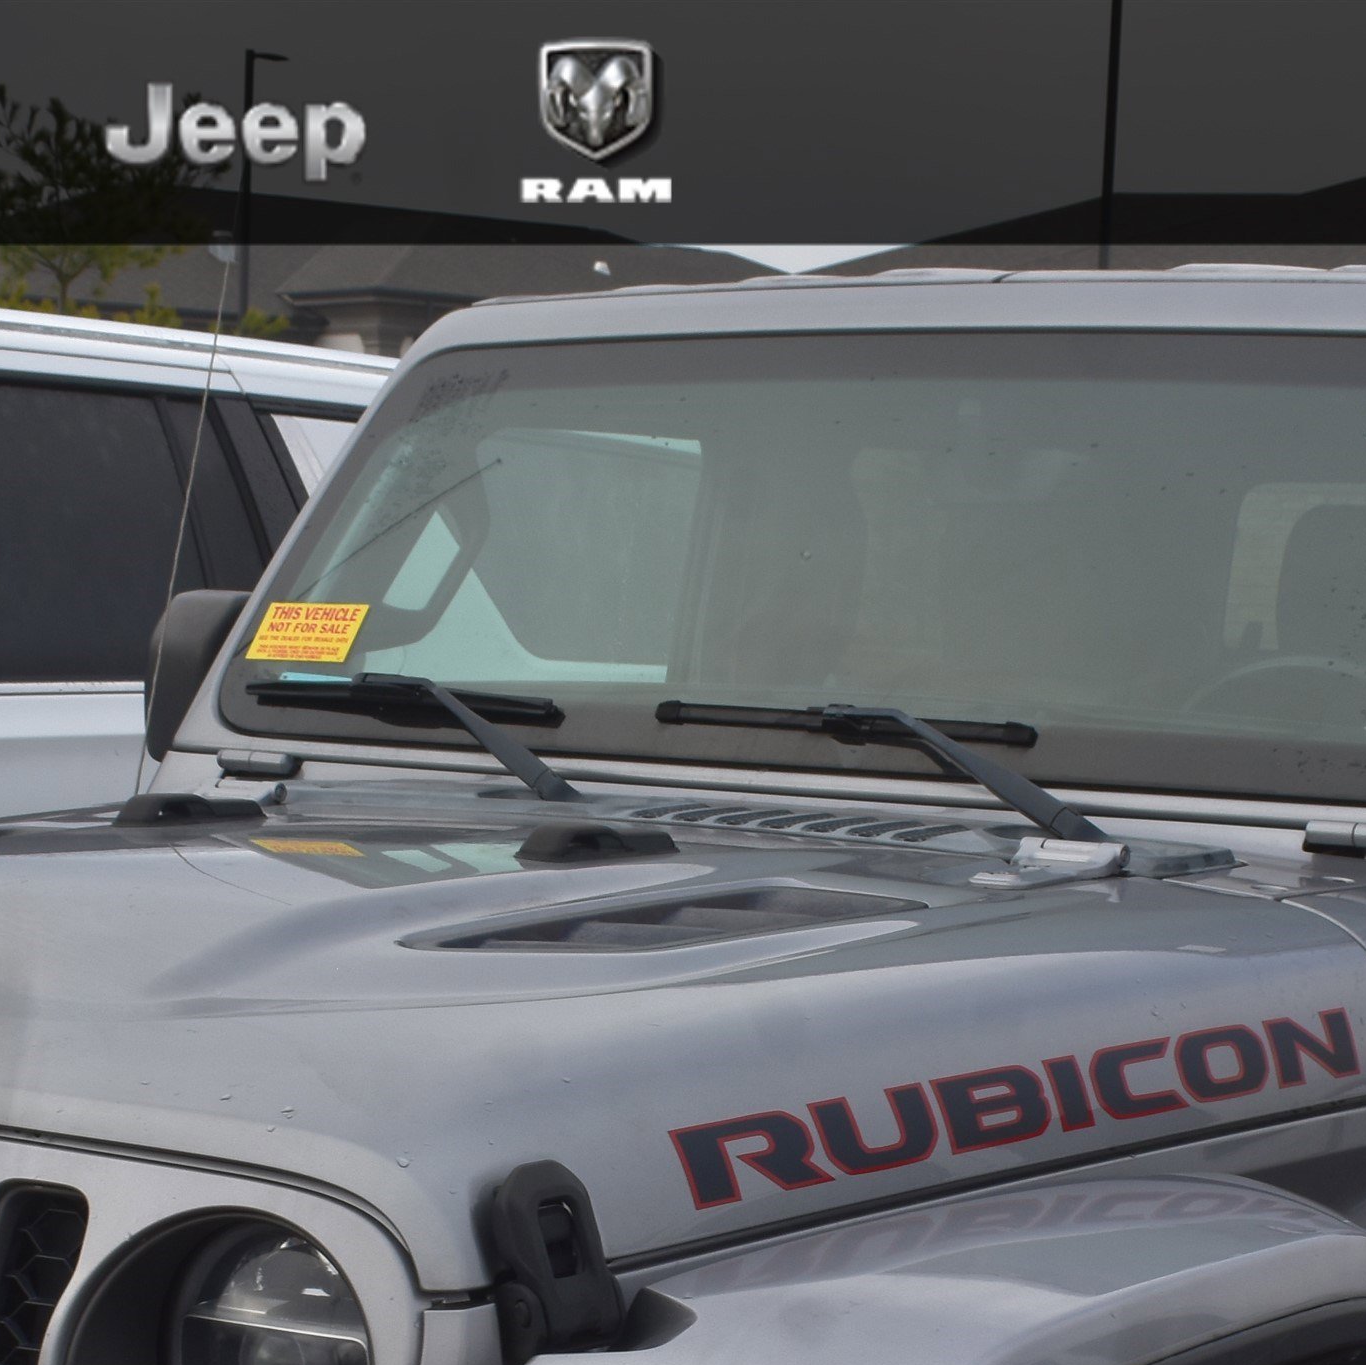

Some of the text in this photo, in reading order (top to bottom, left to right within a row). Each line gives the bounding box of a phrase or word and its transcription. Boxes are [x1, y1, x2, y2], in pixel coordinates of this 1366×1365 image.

[271, 606, 361, 622] THIS VEHICLE
[267, 622, 350, 635] NOT FOR SALE
[667, 1006, 1360, 1210] RUBICON
